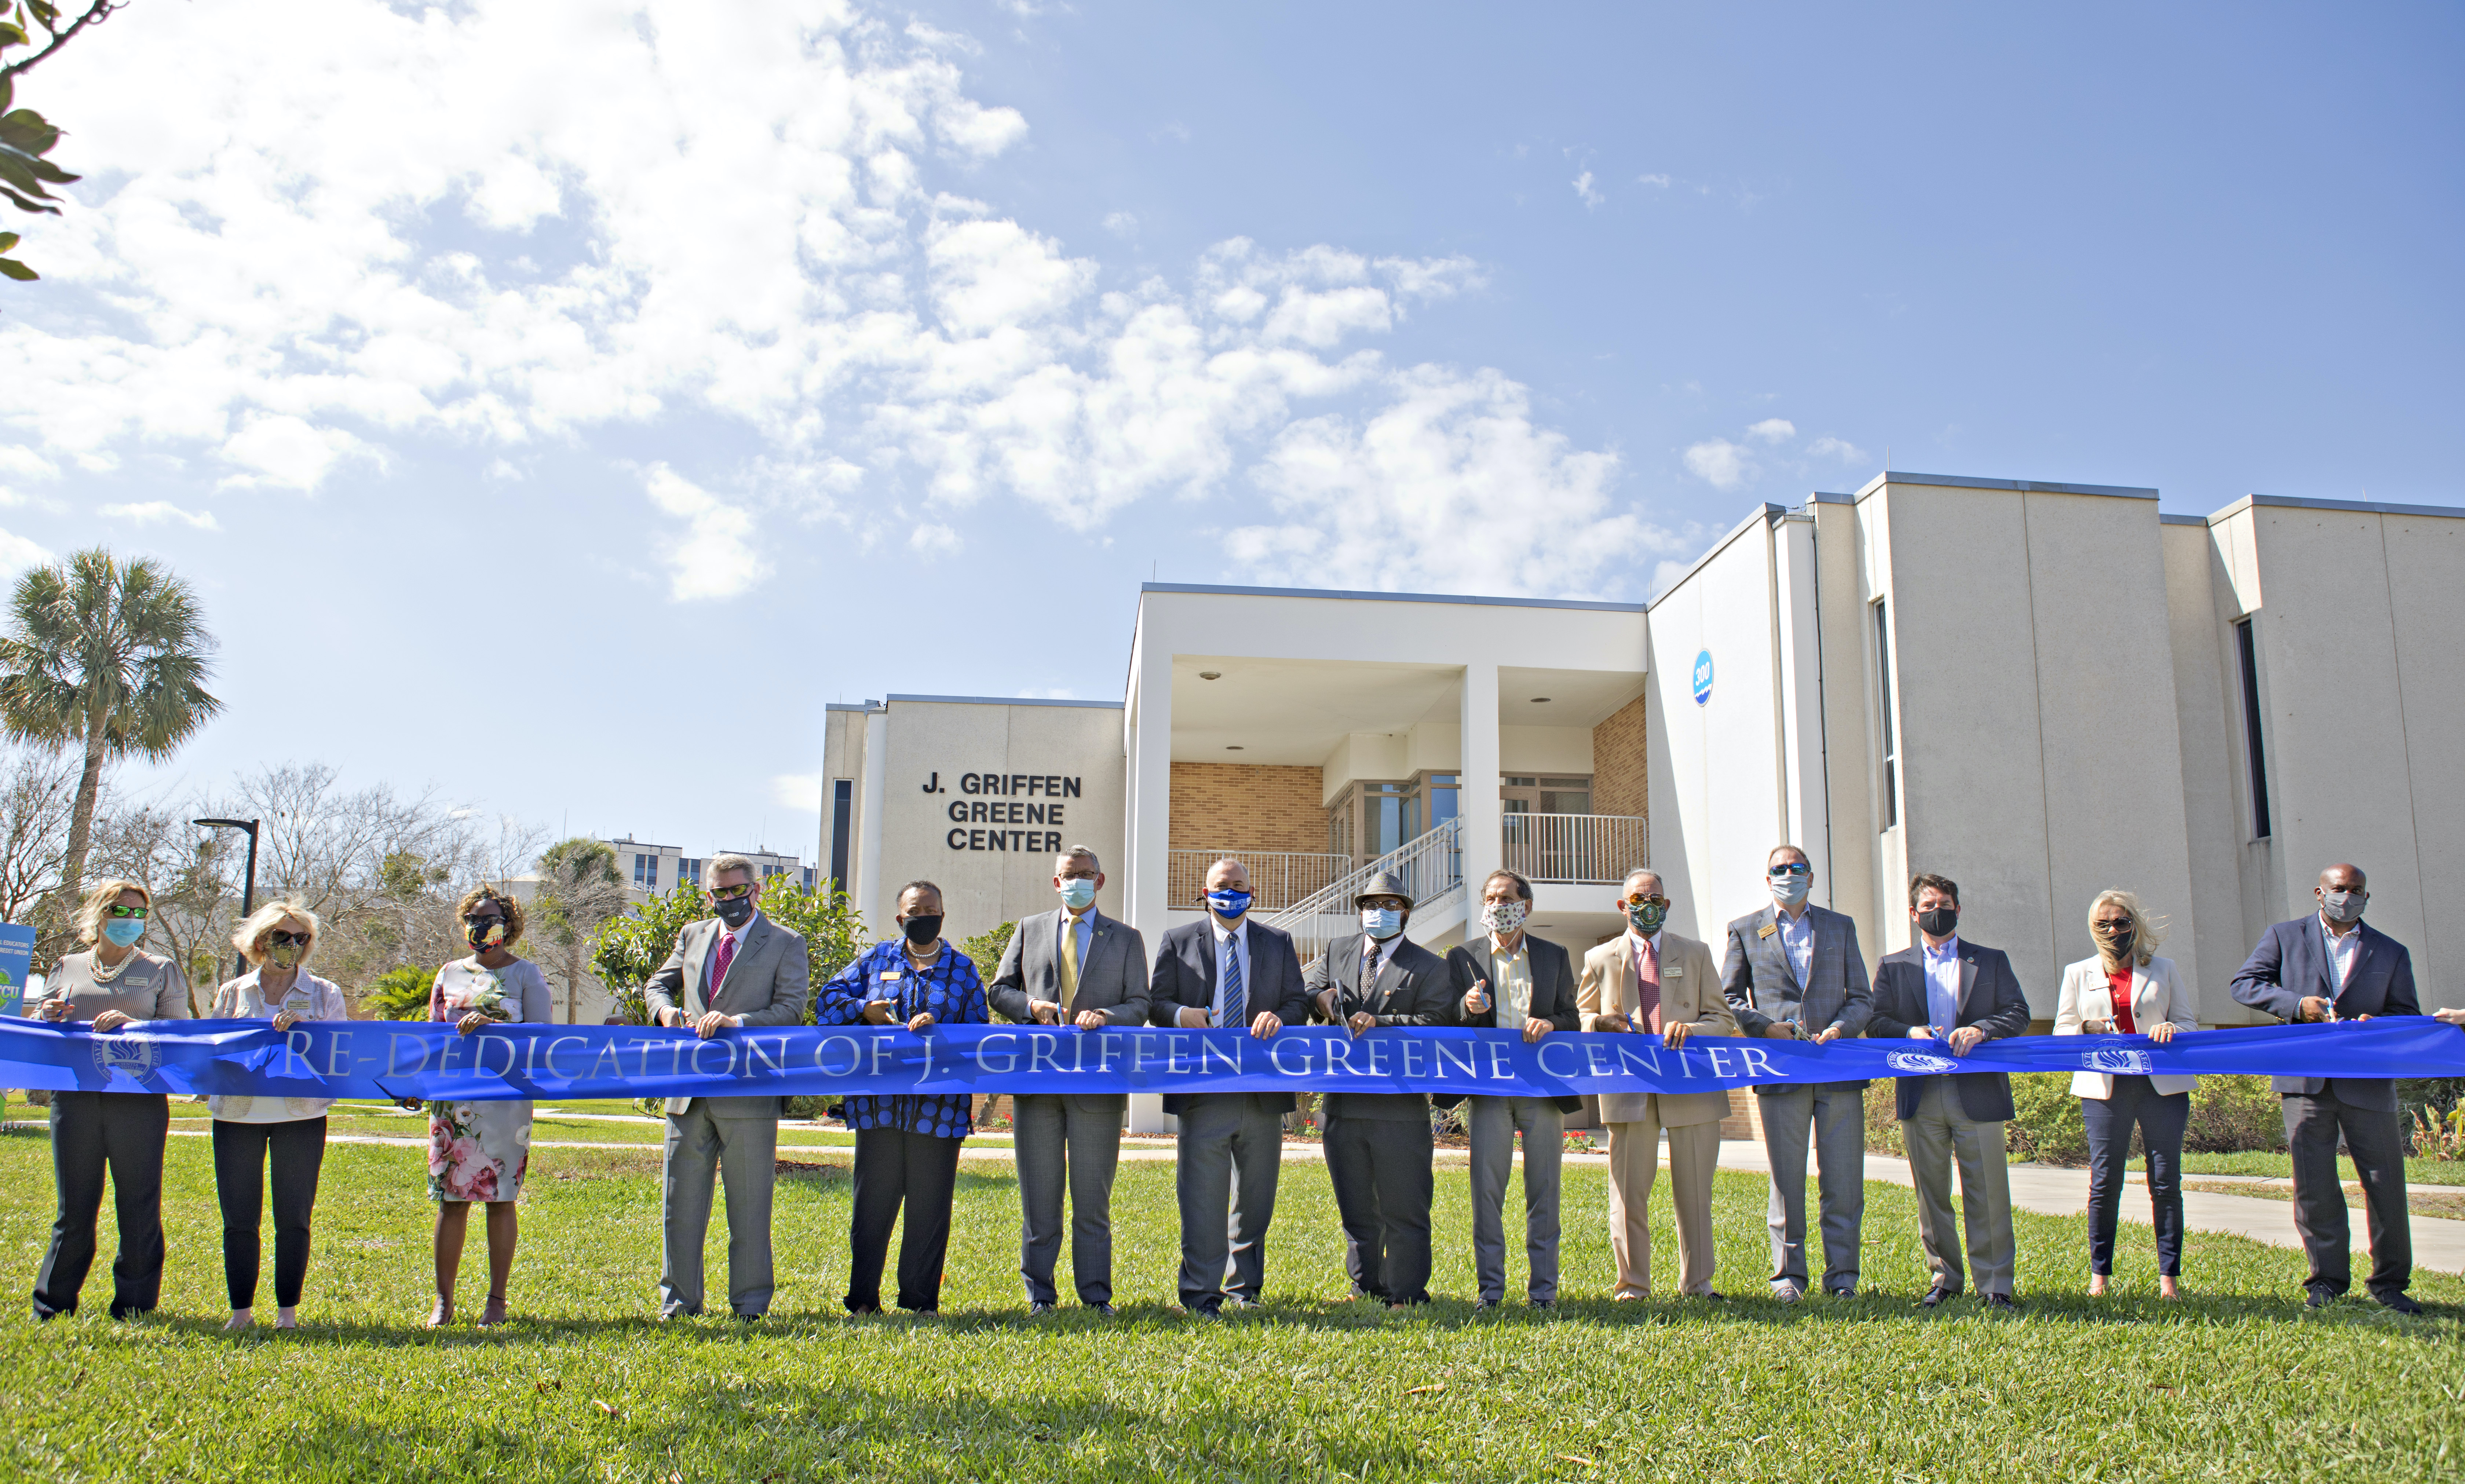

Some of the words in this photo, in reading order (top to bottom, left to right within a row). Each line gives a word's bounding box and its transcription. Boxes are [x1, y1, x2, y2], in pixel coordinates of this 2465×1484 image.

[1695, 661, 1710, 686] 300
[923, 772, 945, 793] J.
[961, 773, 1081, 798] GRIFFEN
[949, 800, 1064, 825] GREENE
[947, 828, 1062, 852] CENTER
[0, 945, 14, 954] REDIT
[3, 940, 29, 948] EDUCATORS
[282, 1030, 791, 1085] RE-DEDICATION
[814, 1035, 895, 1077] OF
[914, 1035, 949, 1085] J.
[976, 1033, 1244, 1075] GRIFFEN
[1271, 1037, 1515, 1079] GREENE
[1537, 1041, 1789, 1078] CENTER
[2084, 1046, 2096, 1069] AYTONA
